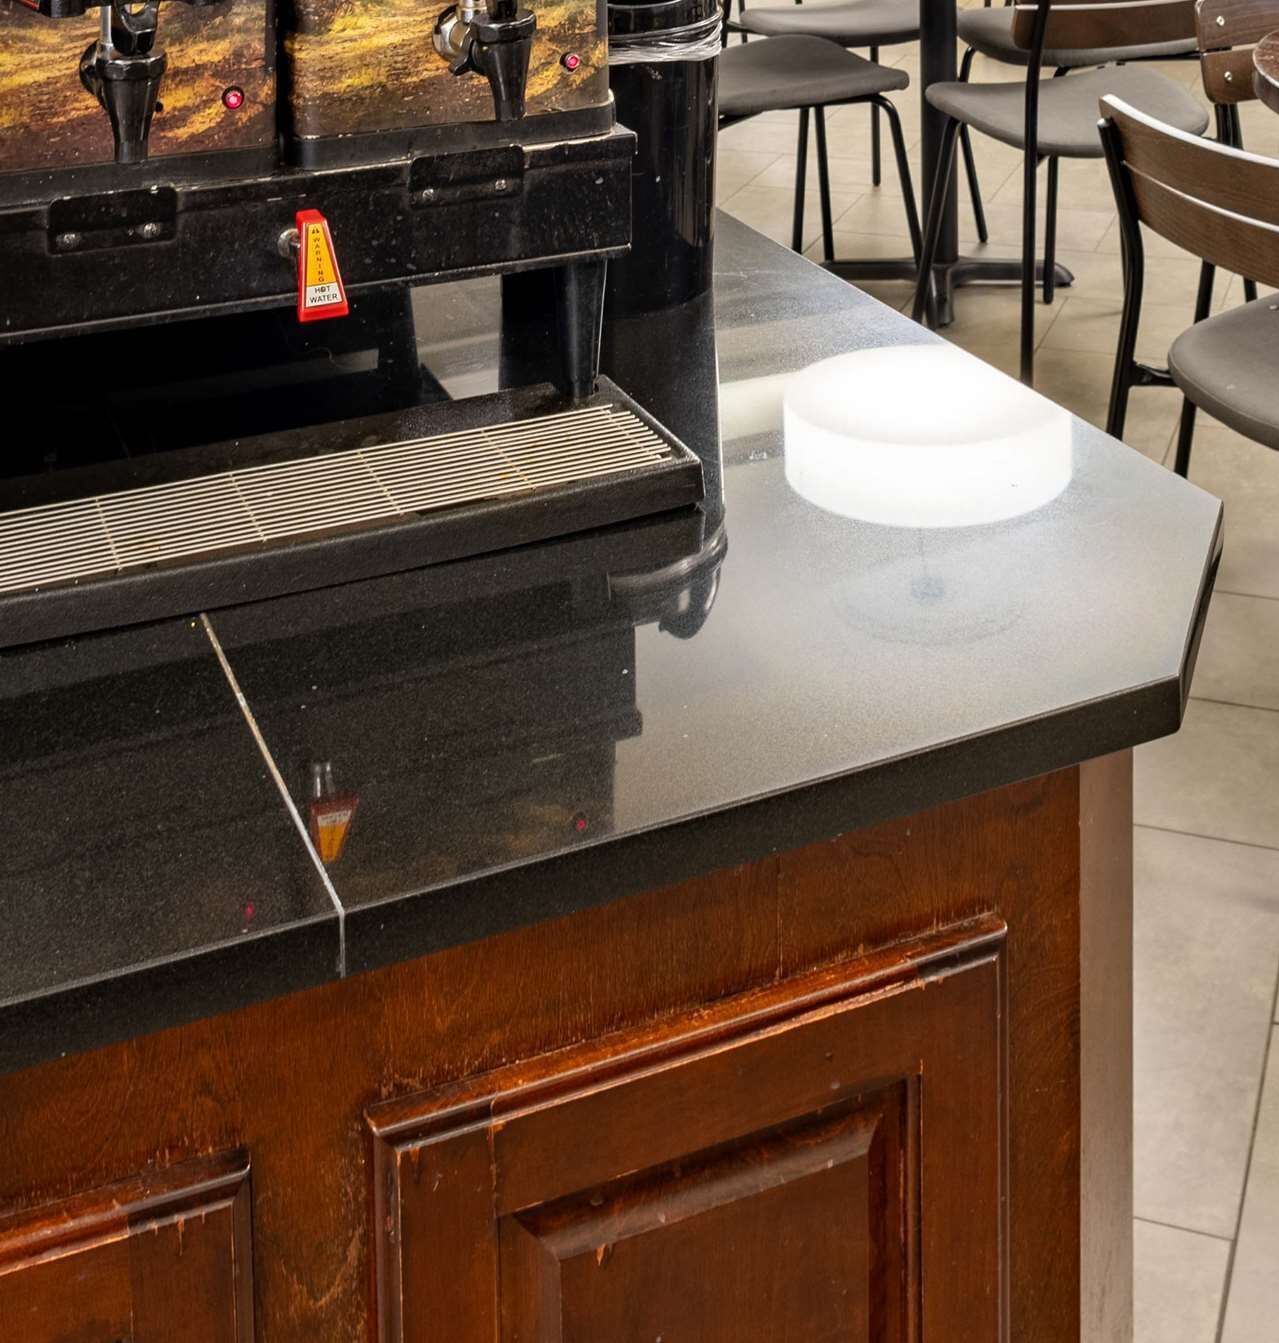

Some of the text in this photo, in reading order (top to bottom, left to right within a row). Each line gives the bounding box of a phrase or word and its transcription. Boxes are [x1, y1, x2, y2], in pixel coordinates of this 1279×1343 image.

[312, 237, 325, 283] WARNING
[314, 285, 331, 294] HOT
[309, 293, 338, 304] WATER
